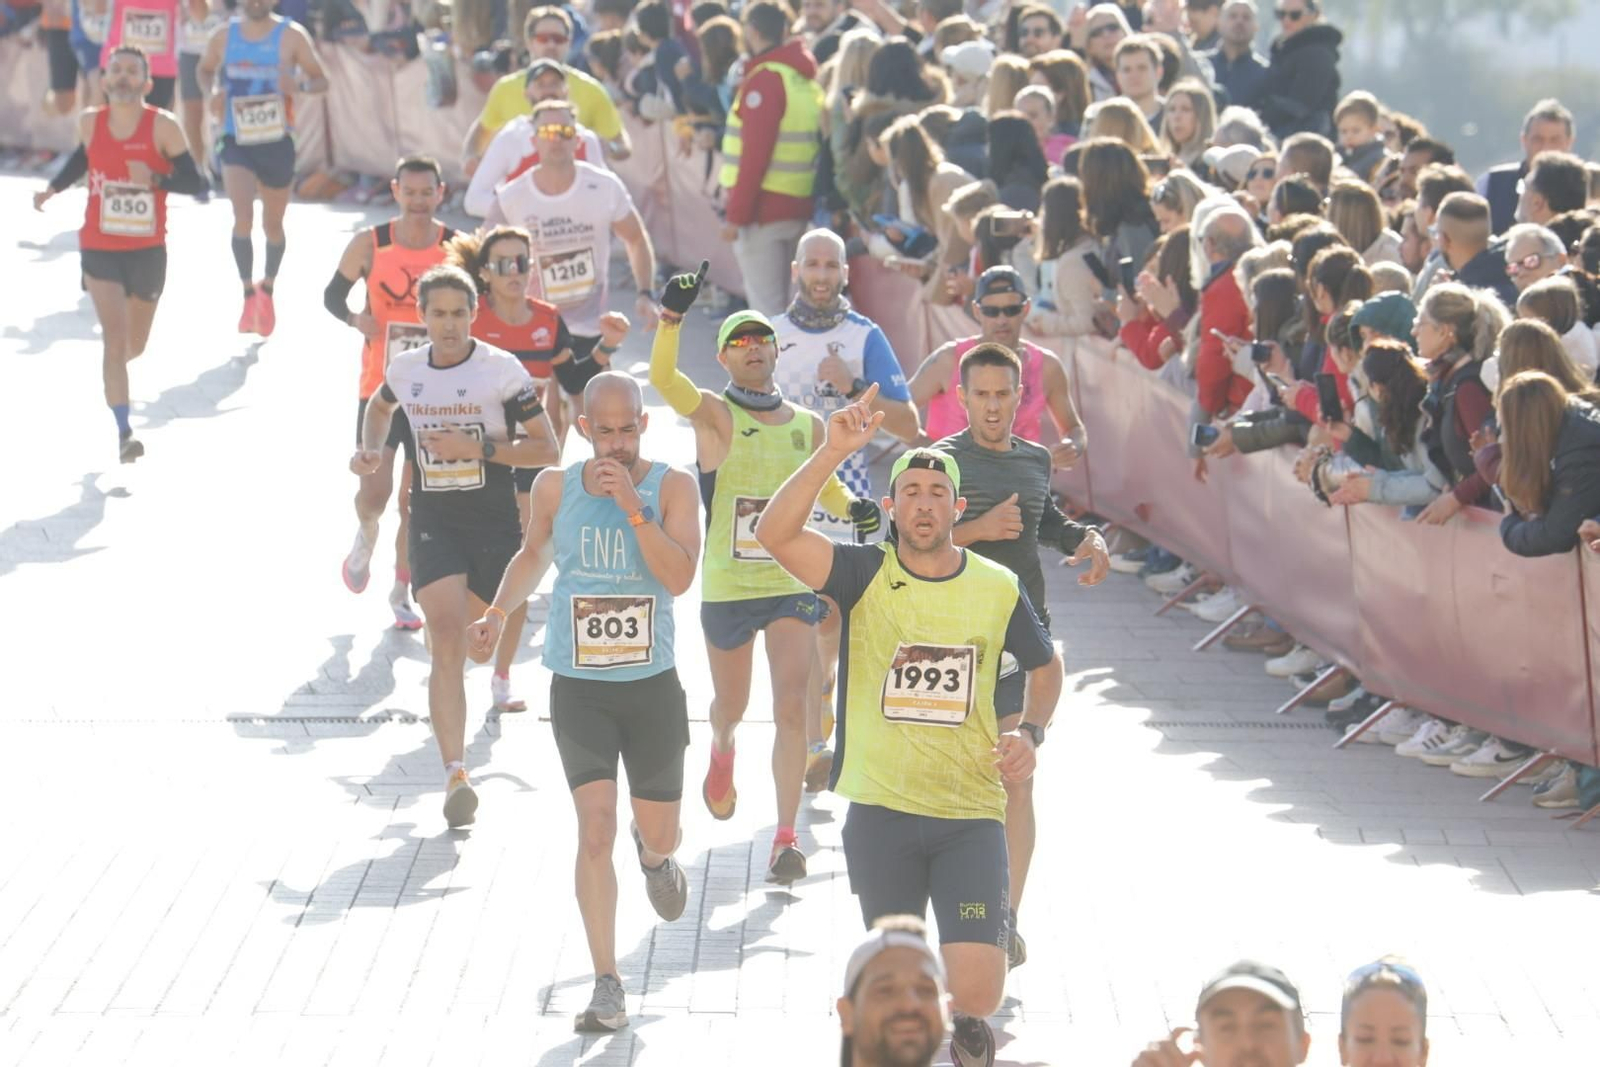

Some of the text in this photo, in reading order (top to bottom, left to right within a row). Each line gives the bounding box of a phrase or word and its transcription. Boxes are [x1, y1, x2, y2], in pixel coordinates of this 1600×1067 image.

[240, 108, 277, 125] 1209
[111, 198, 148, 214] 850
[542, 217, 572, 227] MEDIA
[550, 261, 587, 281] 1218
[405, 403, 482, 416] Tikismikis
[581, 526, 627, 570] ENA
[586, 616, 639, 639] 803
[893, 665, 961, 693] 1993
